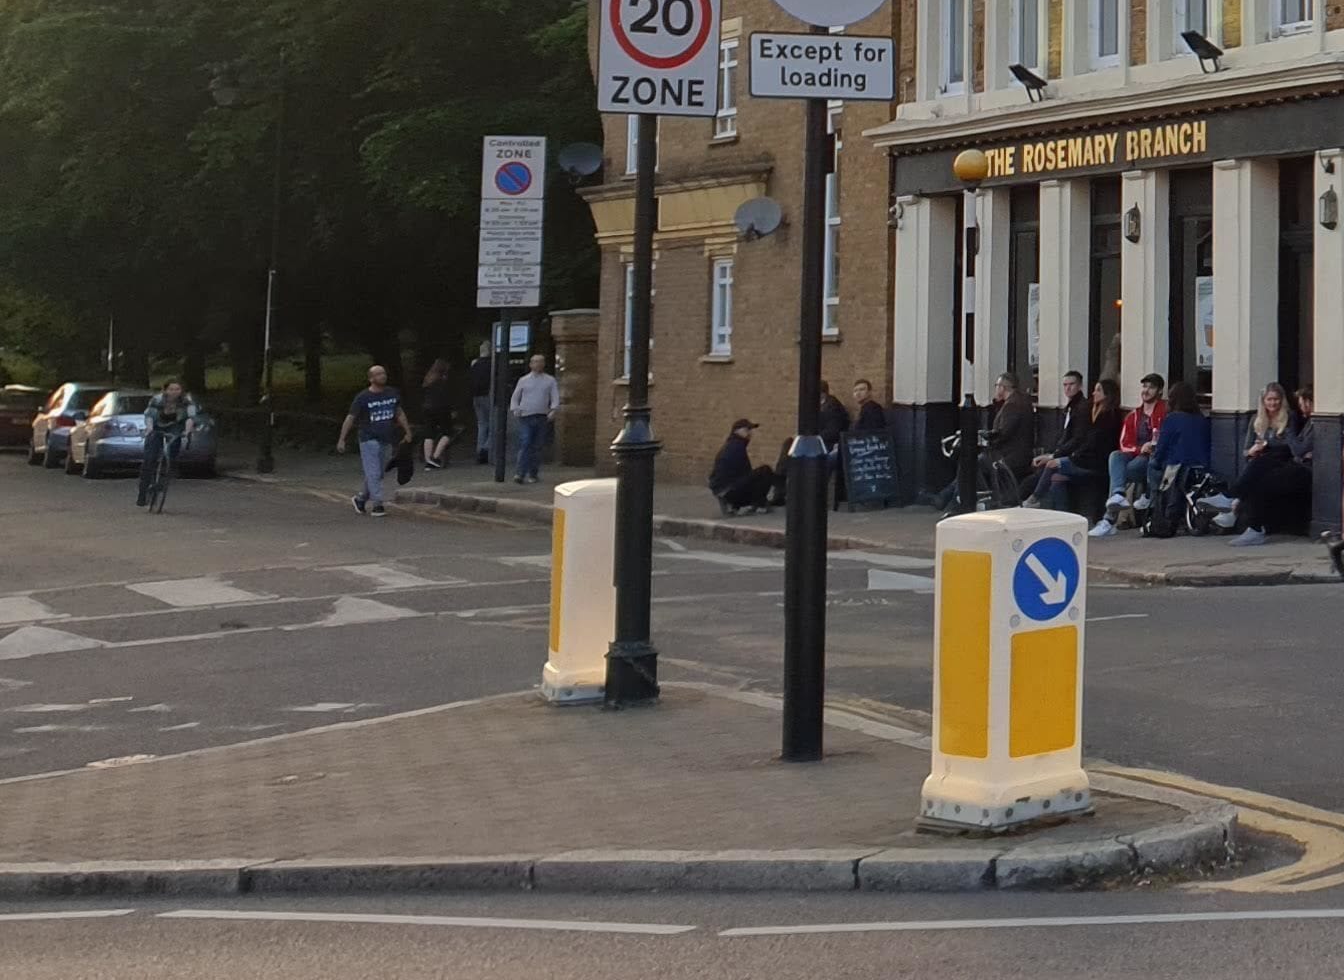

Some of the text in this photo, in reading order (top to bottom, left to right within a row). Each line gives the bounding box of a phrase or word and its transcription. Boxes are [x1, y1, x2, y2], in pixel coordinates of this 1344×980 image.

[759, 38, 886, 64] Except for
[611, 75, 704, 107] ZONE
[781, 66, 867, 92] loading
[496, 149, 532, 158] ZONE
[984, 120, 1207, 178] THE ROSEMARY BRANCH
